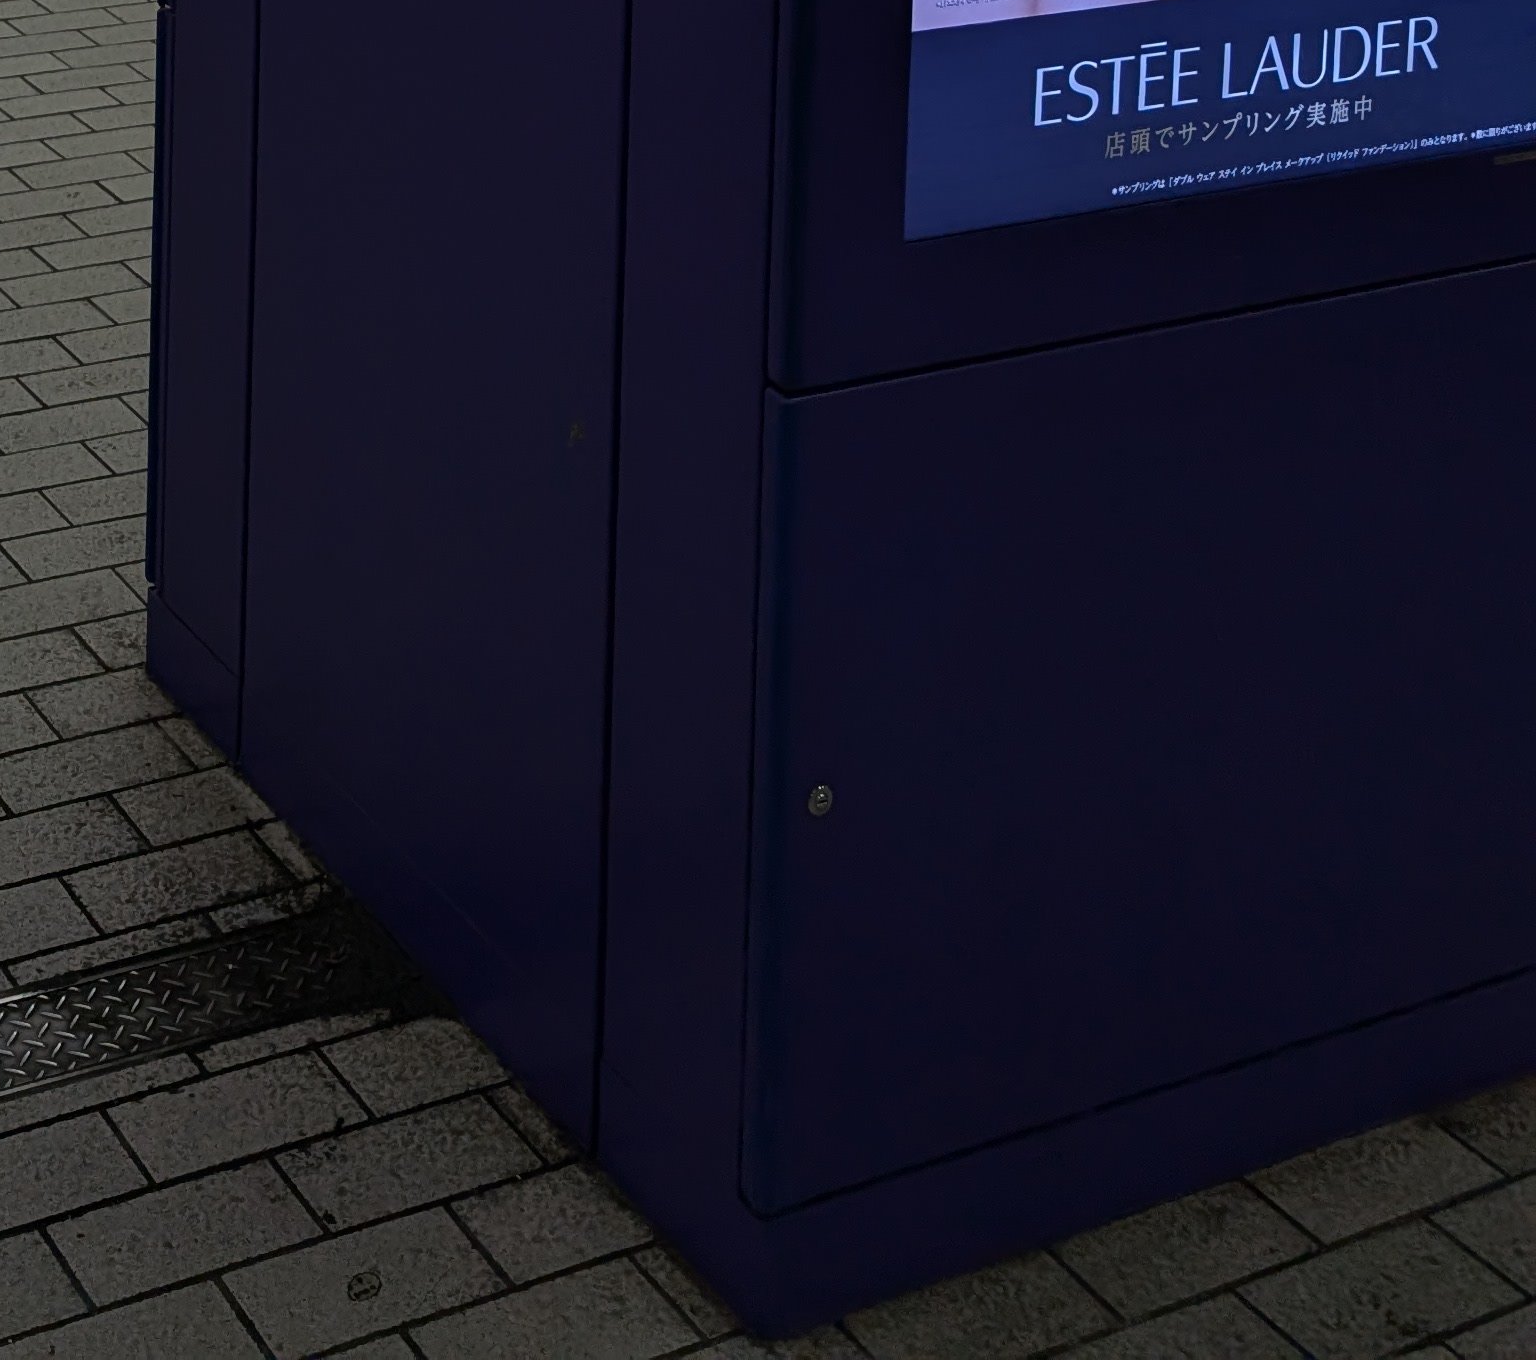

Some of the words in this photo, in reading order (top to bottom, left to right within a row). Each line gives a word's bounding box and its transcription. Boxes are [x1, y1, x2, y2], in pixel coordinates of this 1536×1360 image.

[1221, 16, 1439, 99] LAUDER
[1104, 94, 1374, 159] 店頭でサンプリング実施中
